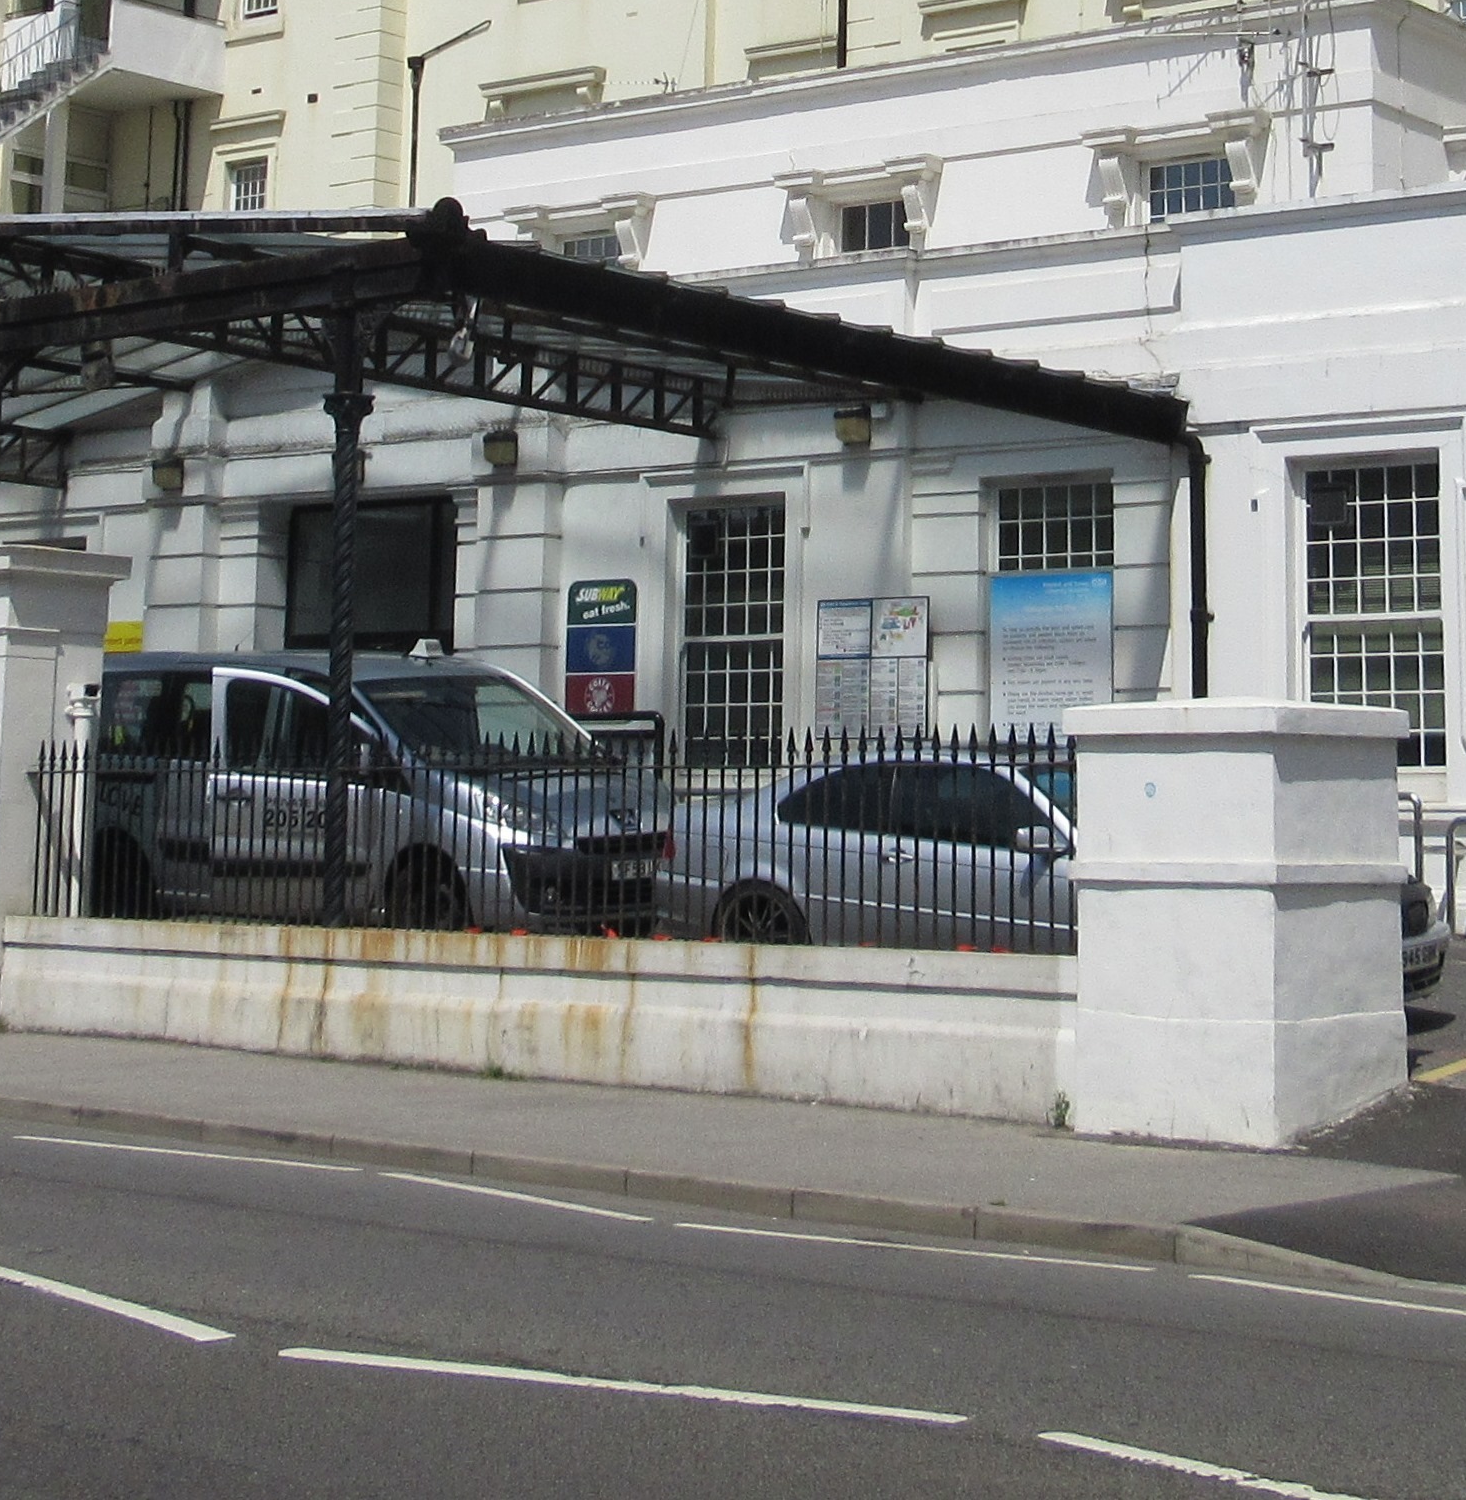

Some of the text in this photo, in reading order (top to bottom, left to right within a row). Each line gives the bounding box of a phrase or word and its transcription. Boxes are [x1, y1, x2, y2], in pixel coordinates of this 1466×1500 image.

[576, 586, 626, 603] SUBWAY
[583, 605, 599, 619] eat
[264, 808, 299, 828] 205
